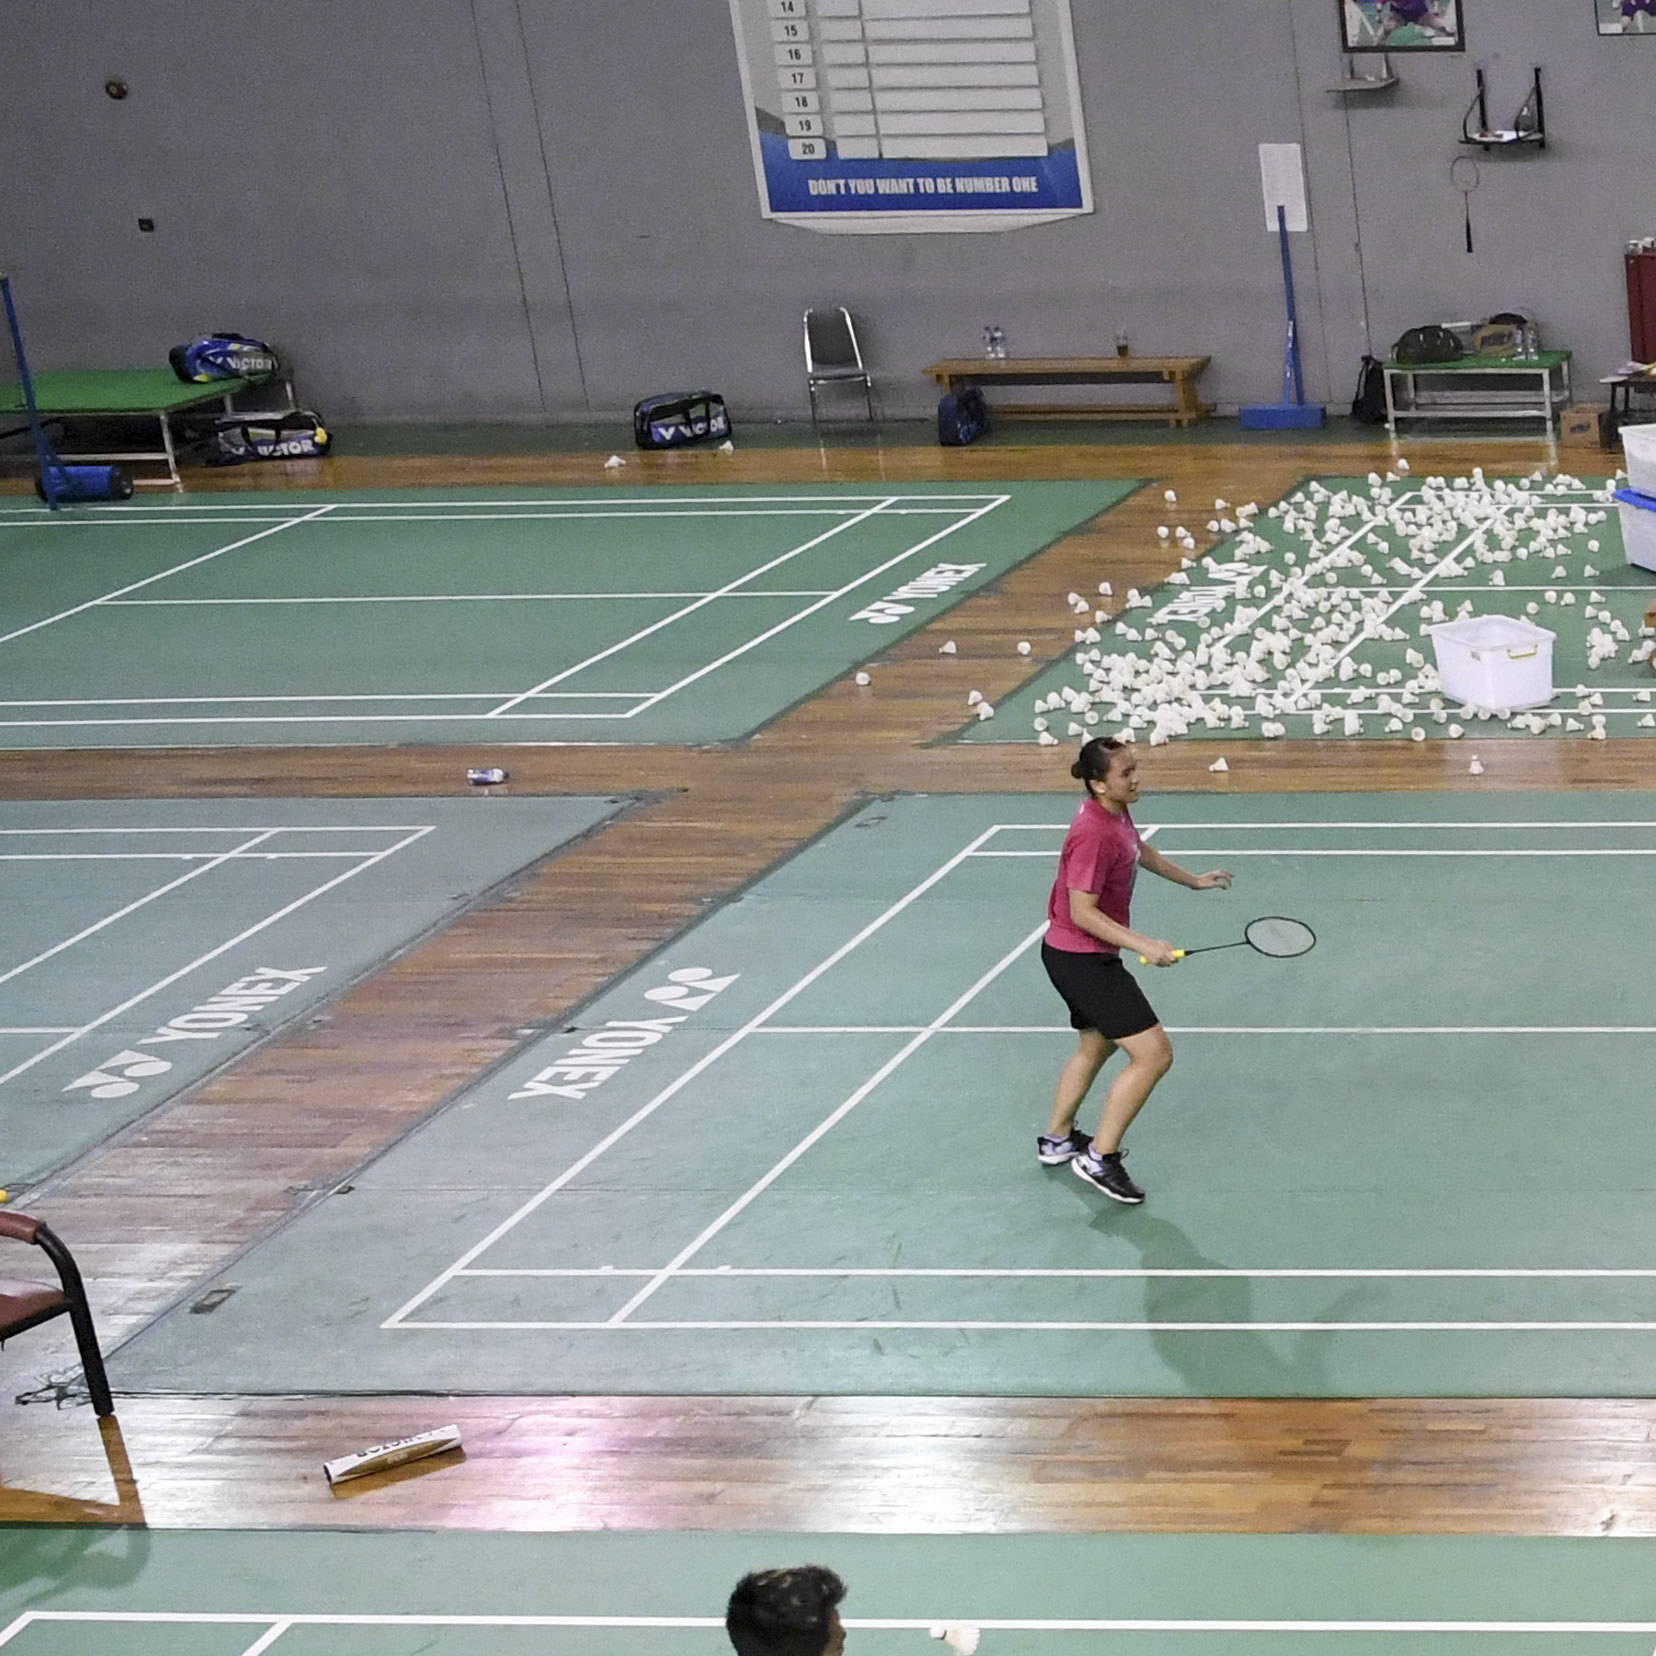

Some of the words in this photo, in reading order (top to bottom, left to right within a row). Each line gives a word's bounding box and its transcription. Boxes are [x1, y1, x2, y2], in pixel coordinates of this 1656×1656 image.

[784, 25, 798, 37] 15
[788, 48, 802, 60] 16
[791, 72, 804, 84] 17
[795, 96, 808, 108] 18
[798, 120, 812, 132] 19
[801, 143, 815, 155] 20
[808, 178, 847, 195] DON'T
[848, 178, 875, 195] YOU
[876, 178, 915, 195] WANT
[917, 177, 935, 194] TO
[937, 177, 954, 194] BE
[956, 176, 1010, 193] NUMBER
[1012, 176, 1038, 193] ONE
[137, 966, 328, 1045] YONEX
[507, 1015, 689, 1100] YONEX
